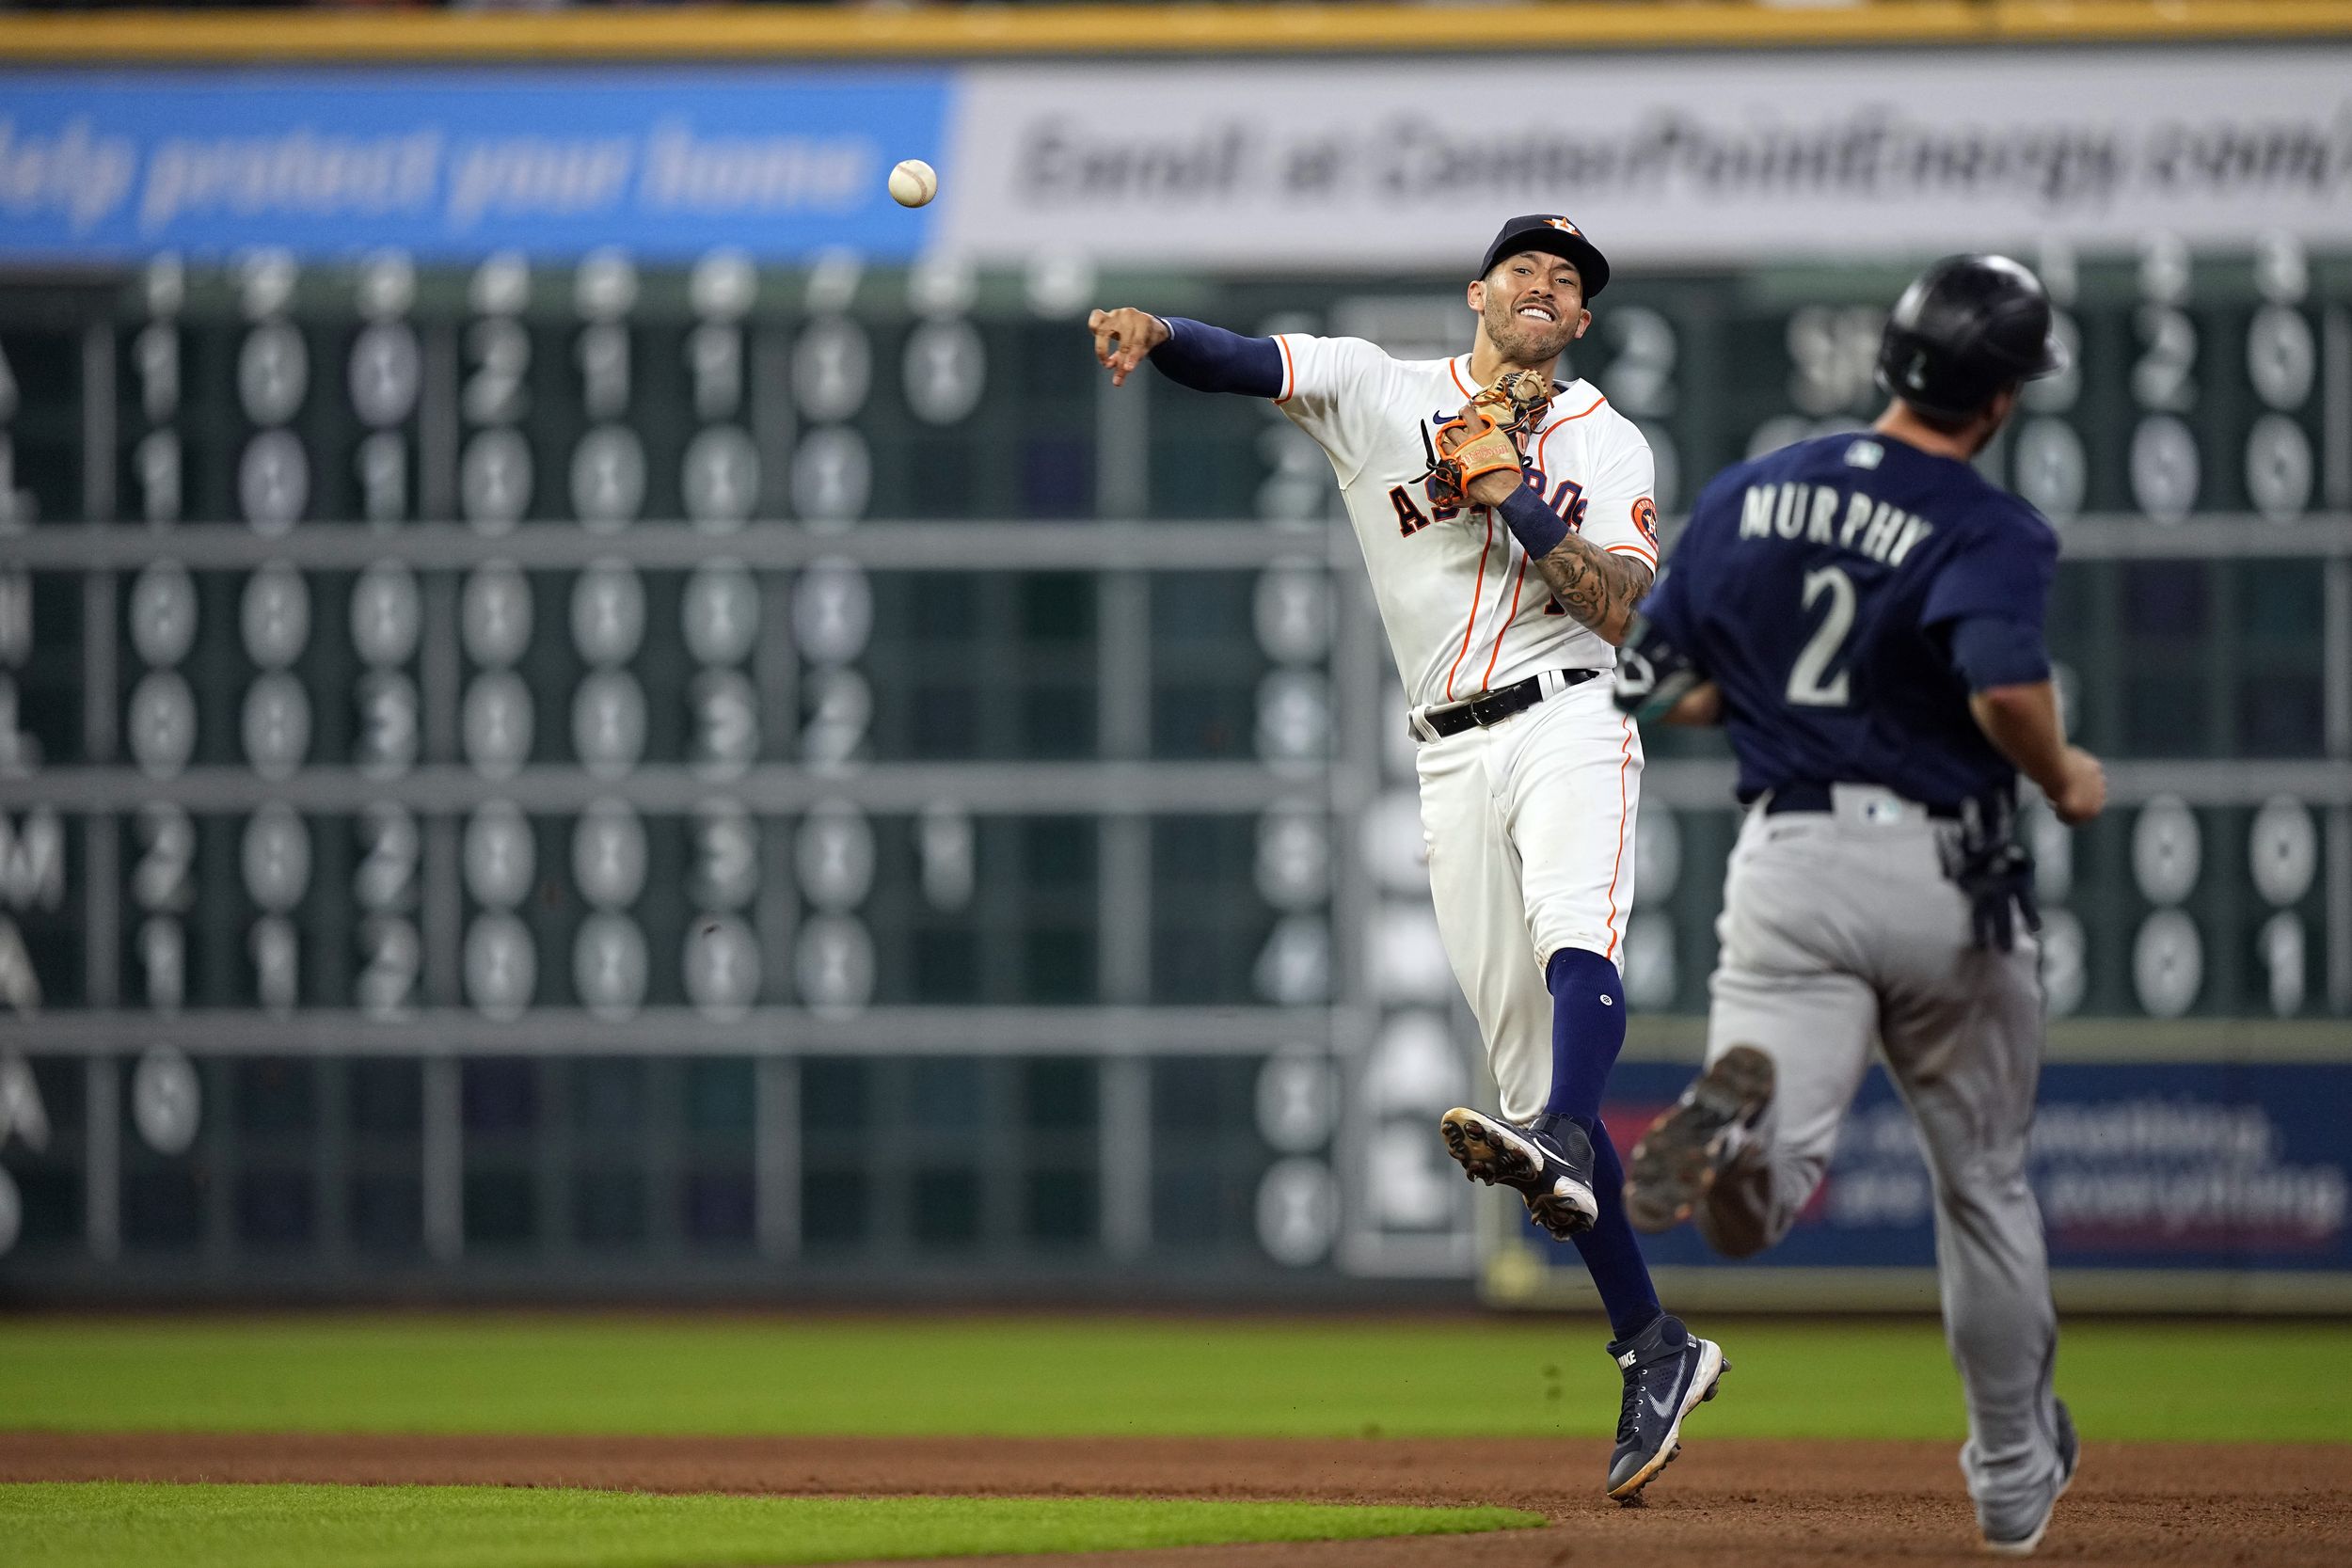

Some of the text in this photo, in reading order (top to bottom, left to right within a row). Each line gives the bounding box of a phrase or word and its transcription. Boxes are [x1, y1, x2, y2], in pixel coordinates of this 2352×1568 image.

[139, 124, 446, 241] protect
[446, 132, 638, 239] your
[643, 113, 882, 214] home
[1016, 111, 1259, 205] Enroll
[1281, 120, 1343, 199] at
[133, 320, 180, 425] 1
[462, 320, 530, 425] 2
[574, 320, 630, 425] 1
[685, 320, 743, 425] 1
[134, 426, 181, 537] 1
[358, 426, 407, 537] 1
[1389, 467, 1587, 537] ASRO
[1739, 481, 1934, 567] MURPHY
[1786, 566, 1857, 707] 2
[135, 911, 184, 1022] 1
[249, 911, 298, 1022] 1
